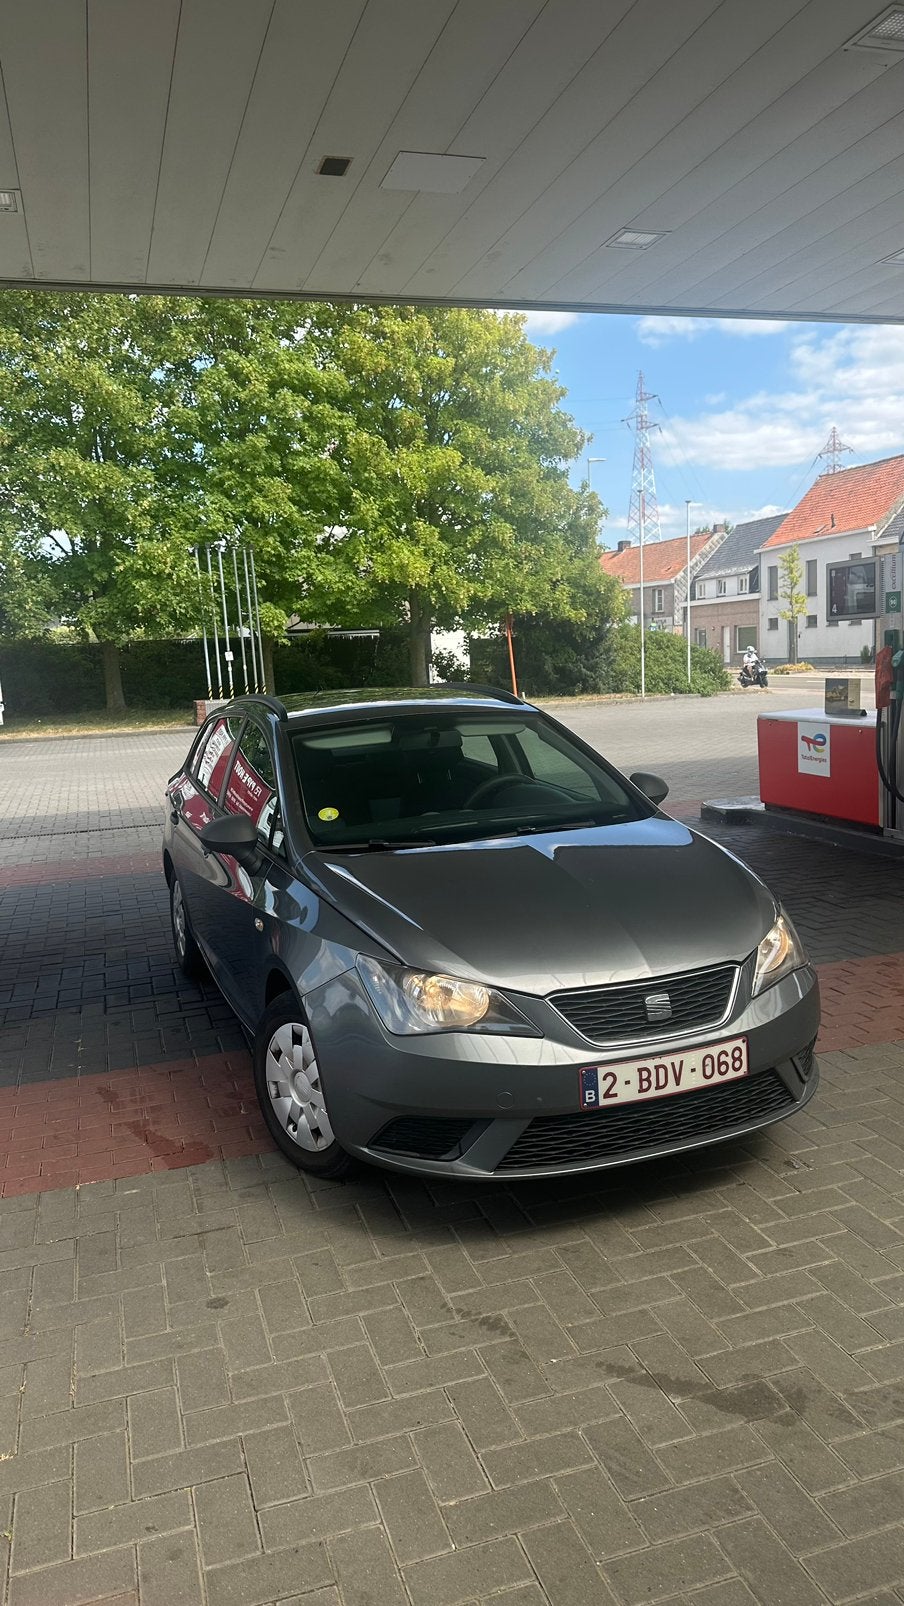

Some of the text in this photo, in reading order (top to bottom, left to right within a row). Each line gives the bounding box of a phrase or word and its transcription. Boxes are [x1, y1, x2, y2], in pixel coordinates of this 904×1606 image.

[832, 604, 838, 614] 4
[801, 754, 827, 763] TotalEnergies
[585, 1090, 596, 1103] B
